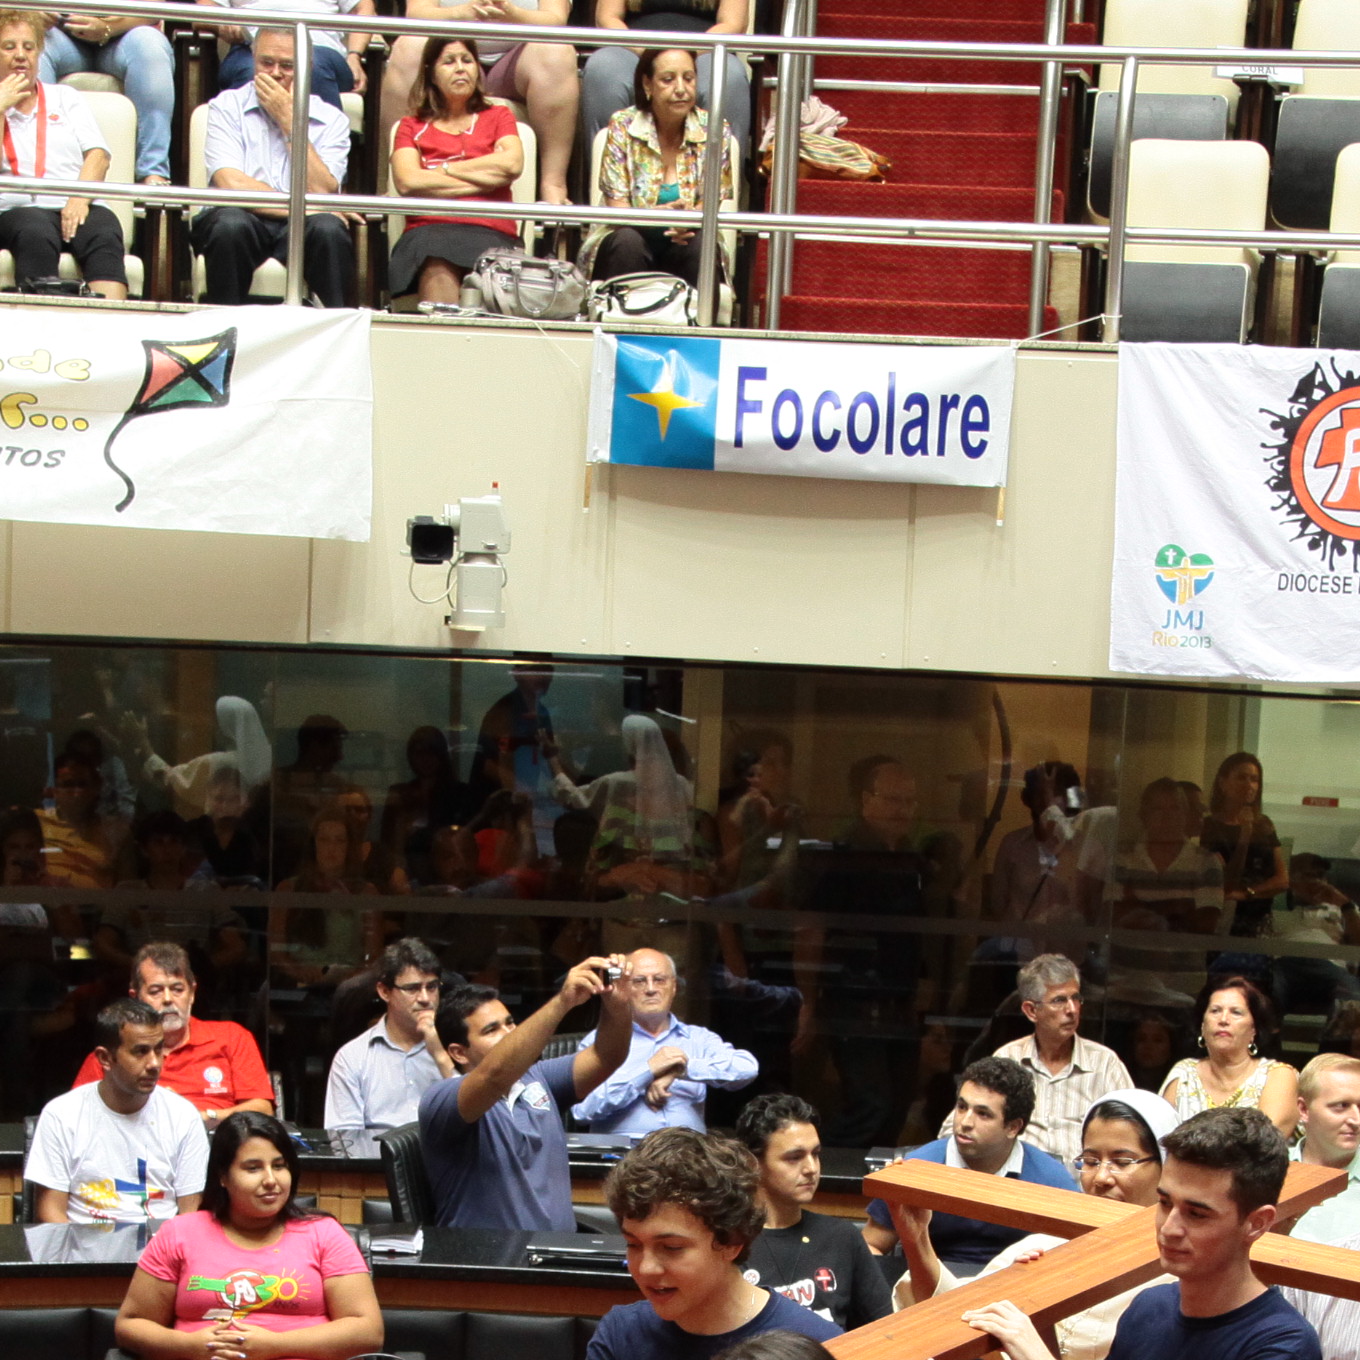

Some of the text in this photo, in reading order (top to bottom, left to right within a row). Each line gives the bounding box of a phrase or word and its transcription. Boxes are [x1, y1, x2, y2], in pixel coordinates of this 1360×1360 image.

[732, 366, 992, 460] Focolare
[1277, 573, 1353, 594] DIOCESE
[1161, 609, 1204, 630] JMJ
